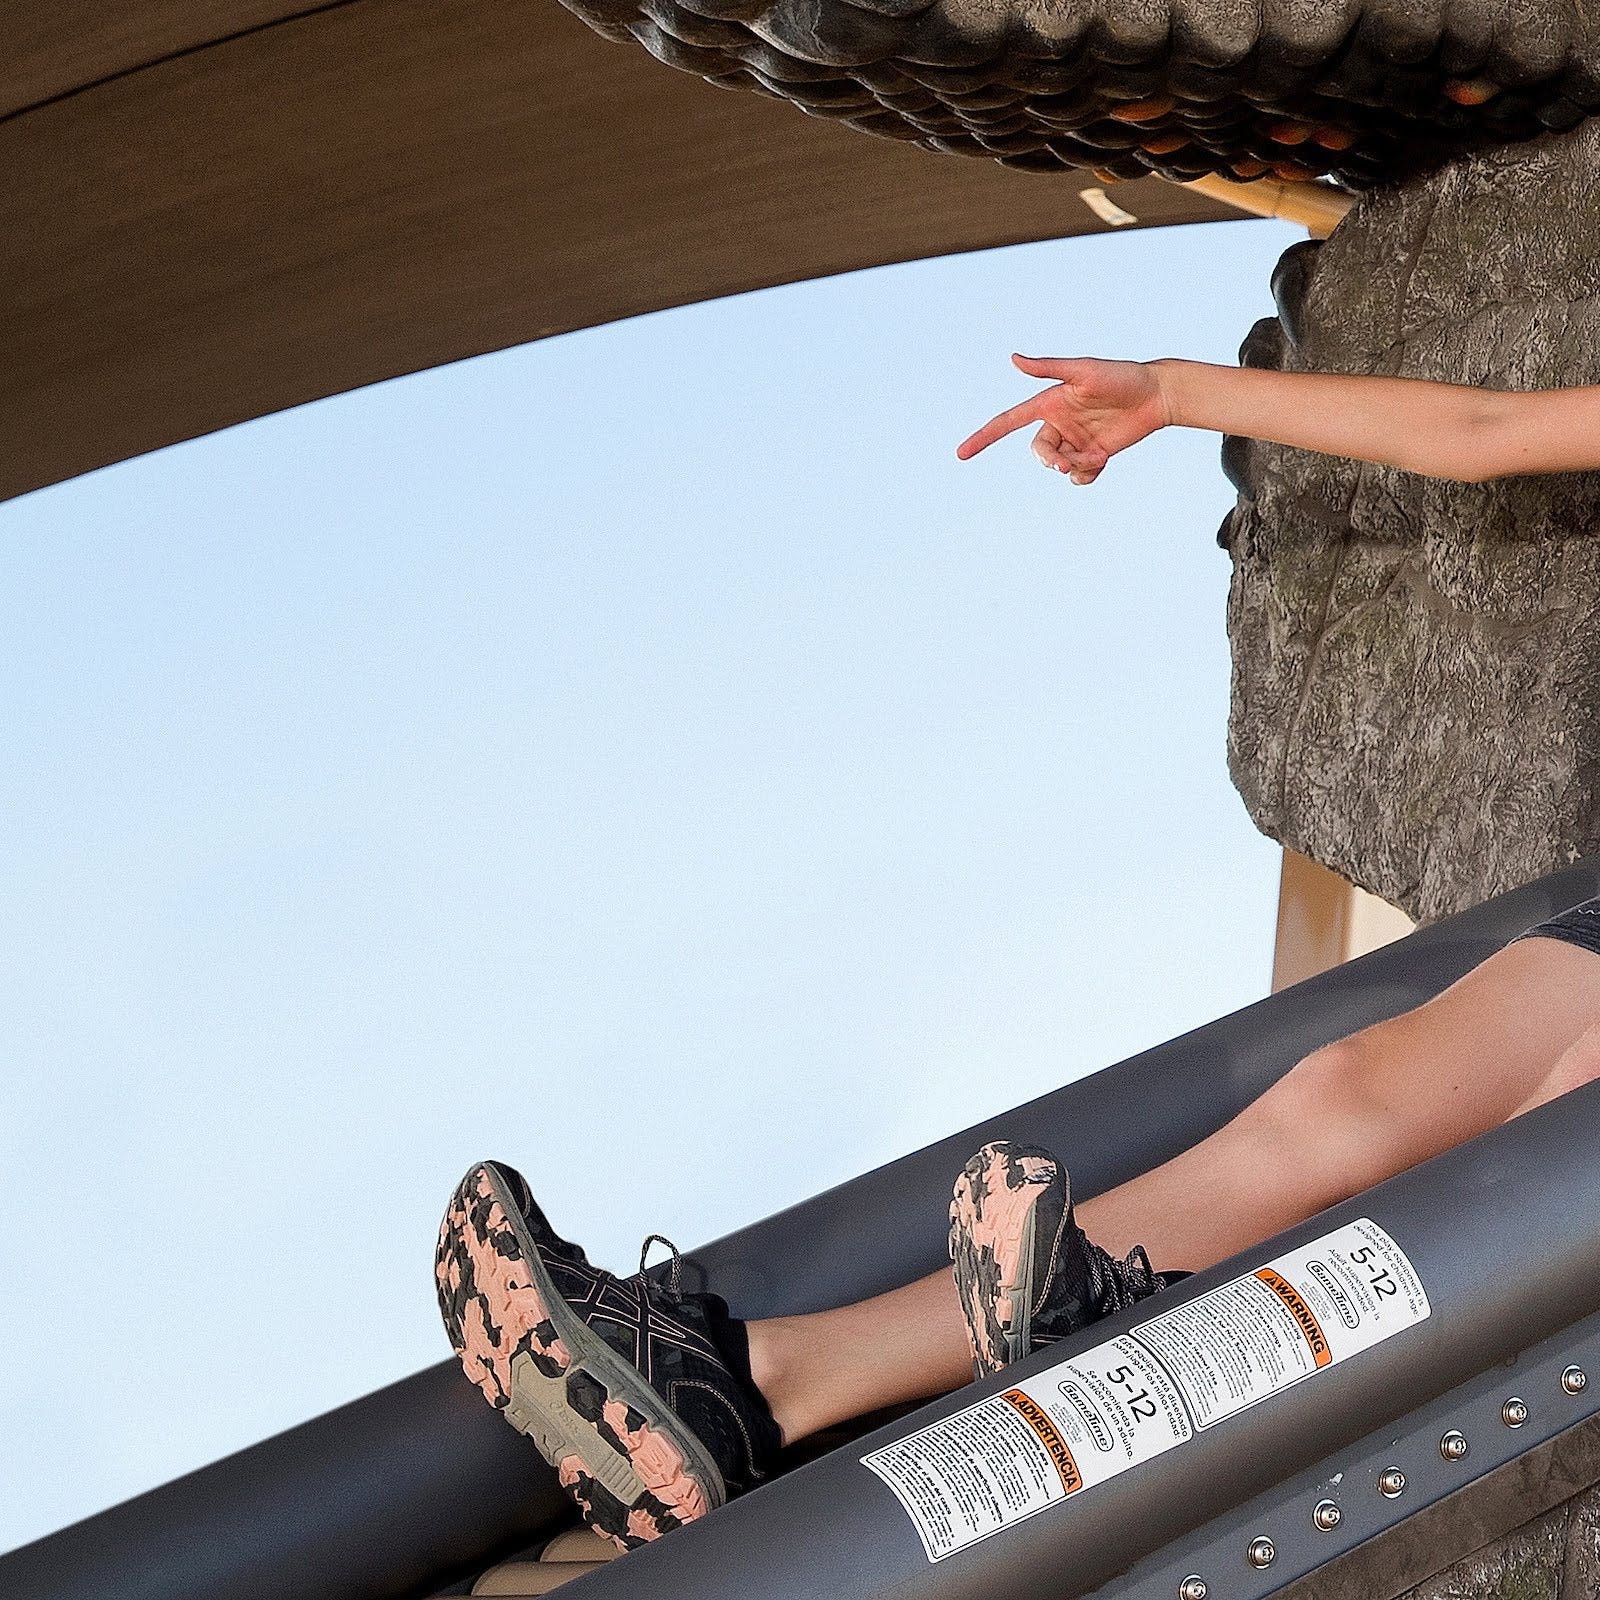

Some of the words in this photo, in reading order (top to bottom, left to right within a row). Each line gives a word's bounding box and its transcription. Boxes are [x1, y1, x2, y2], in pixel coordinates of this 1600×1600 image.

[1311, 1264, 1353, 1323] GameTime
[1328, 1249, 1346, 1265] Adult
[1346, 1265, 1376, 1311] supervision
[1373, 1311, 1380, 1320] is
[1328, 1257, 1369, 1314] recommended.
[1349, 1245, 1394, 1301] 5-12
[1366, 1224, 1379, 1237] This
[1379, 1237, 1394, 1251] play
[1393, 1252, 1420, 1297] equipment
[1417, 1298, 1423, 1306] is
[1382, 1251, 1391, 1262] for
[1390, 1262, 1411, 1296] children
[1275, 1281, 1325, 1354] WARNING
[1063, 1384, 1107, 1446] GameTime
[1067, 1365, 1104, 1401] supervisión
[1102, 1400, 1112, 1413] de
[1110, 1413, 1119, 1425] un
[1116, 1426, 1131, 1459] adulto.
[1086, 1369, 1097, 1379] Se
[1095, 1379, 1129, 1427] recomienda
[1127, 1427, 1134, 1437] la
[1106, 1365, 1155, 1423] 5-12
[1111, 1341, 1128, 1355] para
[1126, 1353, 1145, 1372] jugar
[1144, 1372, 1155, 1385] los
[1153, 1385, 1169, 1410] niños
[1166, 1411, 1179, 1439] edad:
[1118, 1338, 1134, 1349] Este
[1134, 1349, 1158, 1374] equipo
[1156, 1374, 1170, 1393] está
[1167, 1392, 1187, 1437] diseñado
[1014, 1400, 1077, 1489] ADVERTENCIA
